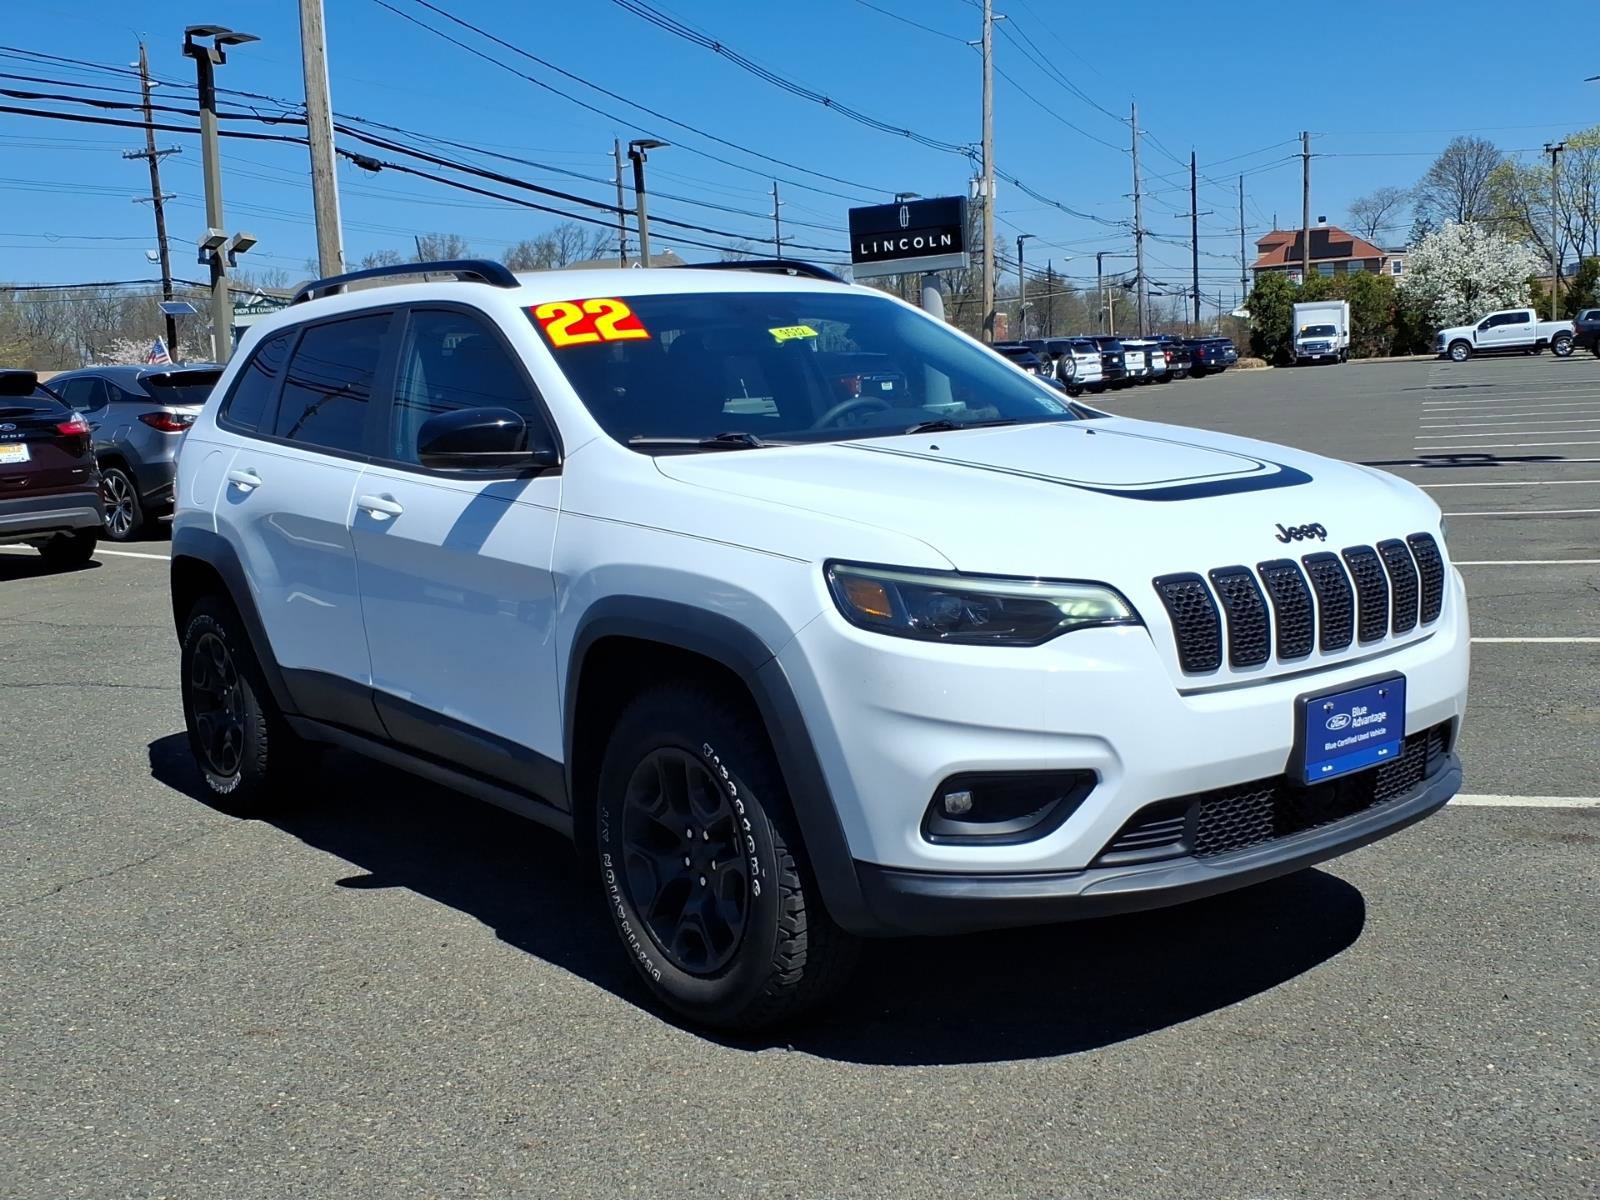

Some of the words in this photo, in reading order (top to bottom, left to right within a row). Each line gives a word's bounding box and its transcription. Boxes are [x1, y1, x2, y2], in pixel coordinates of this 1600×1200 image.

[860, 234, 951, 255] LINCOLN
[535, 298, 650, 347] 22
[1275, 522, 1328, 544] Jeep
[1351, 711, 1387, 728] Advantage
[1352, 706, 1368, 717] Blue
[1324, 742, 1337, 751] Blue
[1337, 735, 1357, 747] Certified
